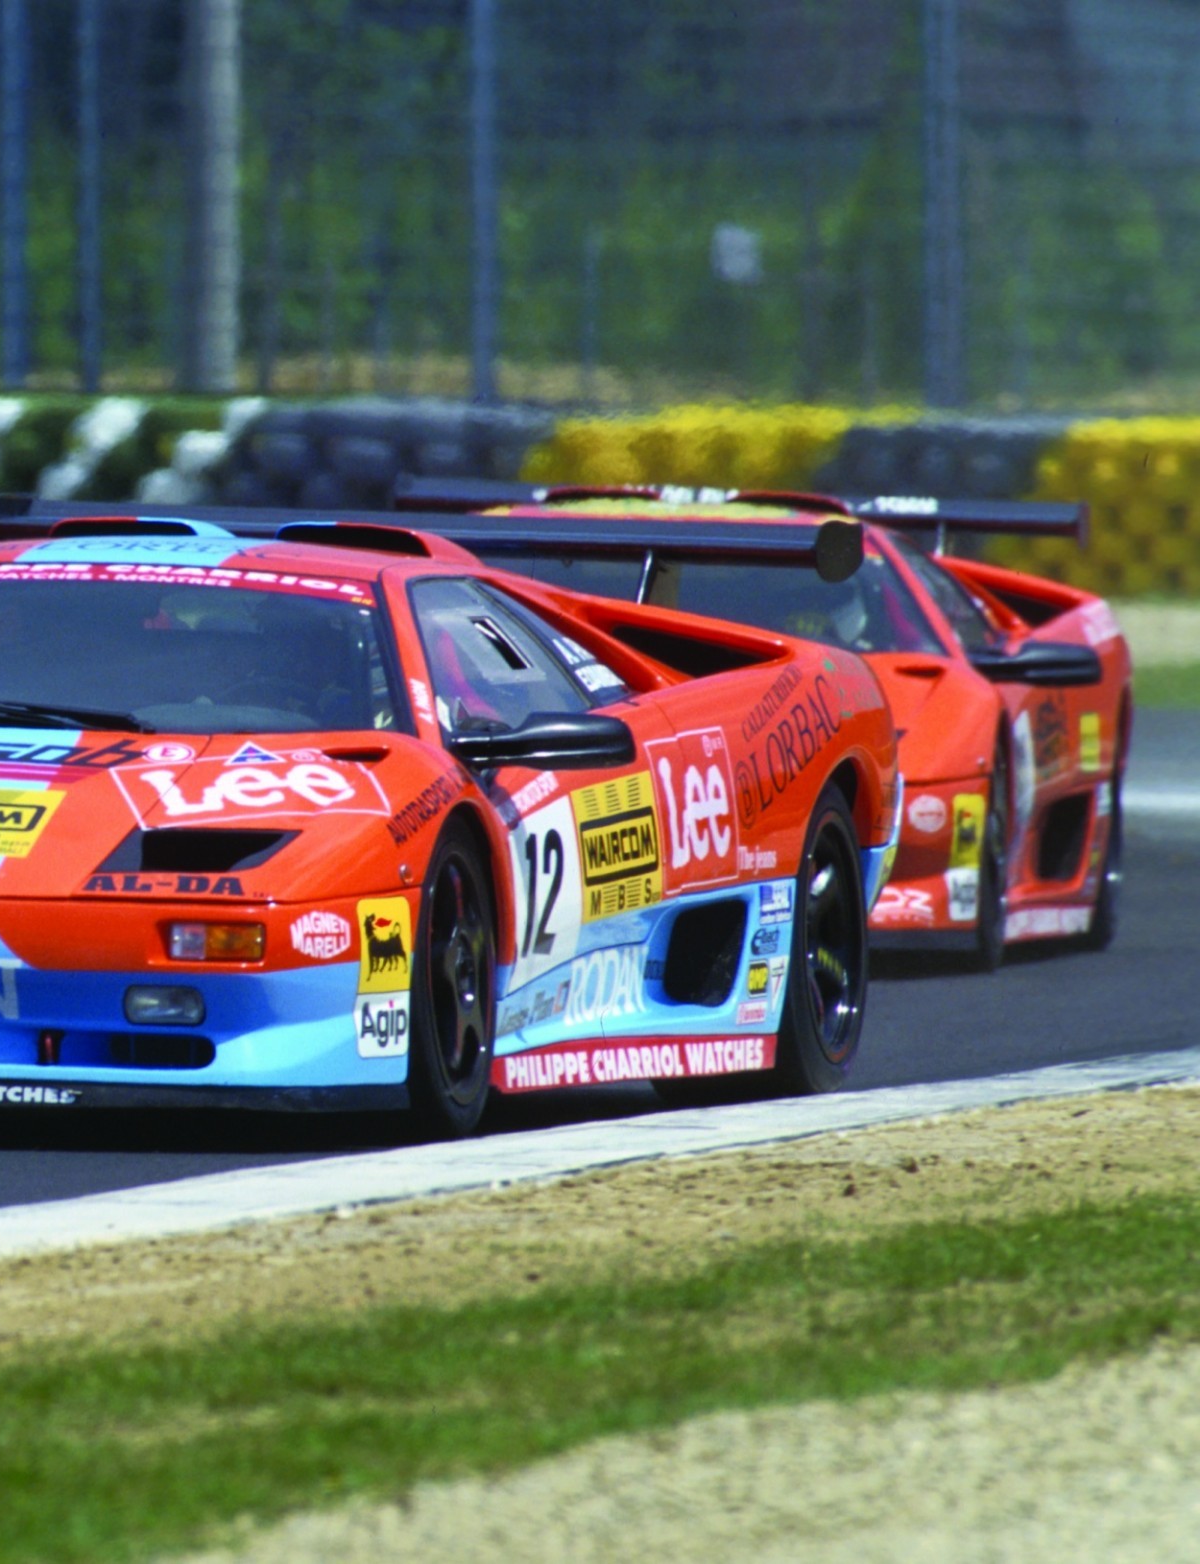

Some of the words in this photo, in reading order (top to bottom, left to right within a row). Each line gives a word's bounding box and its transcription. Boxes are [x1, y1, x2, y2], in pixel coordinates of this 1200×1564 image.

[105, 564, 365, 596] CHARRIOL
[114, 573, 232, 587] MONTRES
[749, 674, 841, 812] LORBAC
[140, 764, 356, 816] Lee
[657, 757, 732, 870] Lee
[584, 822, 655, 870] WAIRCOM
[81, 874, 245, 897] AL-DA
[520, 828, 564, 957] 12
[590, 890, 601, 917] M
[618, 885, 625, 910] B
[645, 878, 652, 905] S
[563, 944, 649, 1026] RODAN
[360, 999, 408, 1048] Agip
[504, 1051, 592, 1089] PHILIPPE
[592, 1044, 684, 1083] CHARRIOL
[684, 1038, 765, 1076] WATCHES
